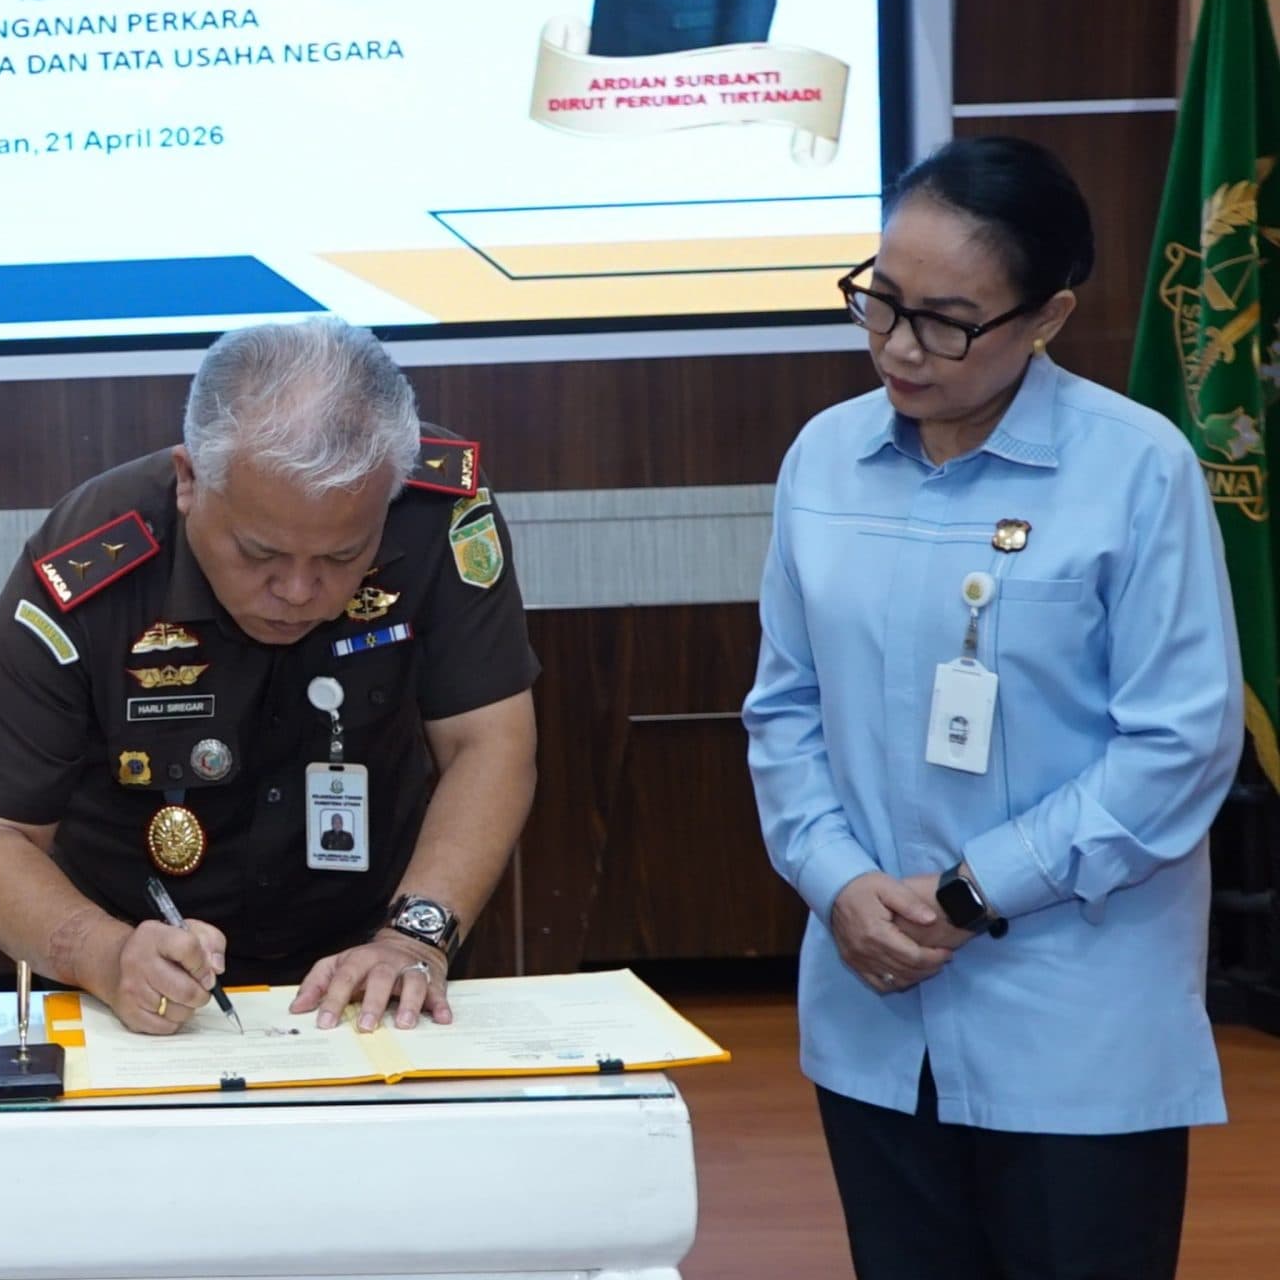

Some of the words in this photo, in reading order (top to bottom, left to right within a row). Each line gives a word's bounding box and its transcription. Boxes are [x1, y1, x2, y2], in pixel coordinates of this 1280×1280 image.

[127, 9, 259, 32] PERKARA
[28, 53, 87, 74] DAN
[98, 50, 164, 70] TATA
[175, 45, 275, 67] USAHA
[284, 39, 405, 63] NEGARA
[589, 76, 666, 91] ARDIAN
[674, 72, 780, 88] SURBAKTI
[549, 96, 606, 111] DIRUT
[615, 93, 707, 109] PERUMDA
[720, 89, 822, 104] TIRTANADI
[46, 133, 73, 152] 21
[84, 129, 152, 153] April
[159, 126, 224, 148] 2026
[138, 704, 163, 714] HARLI
[167, 702, 204, 713] SIREGAR
